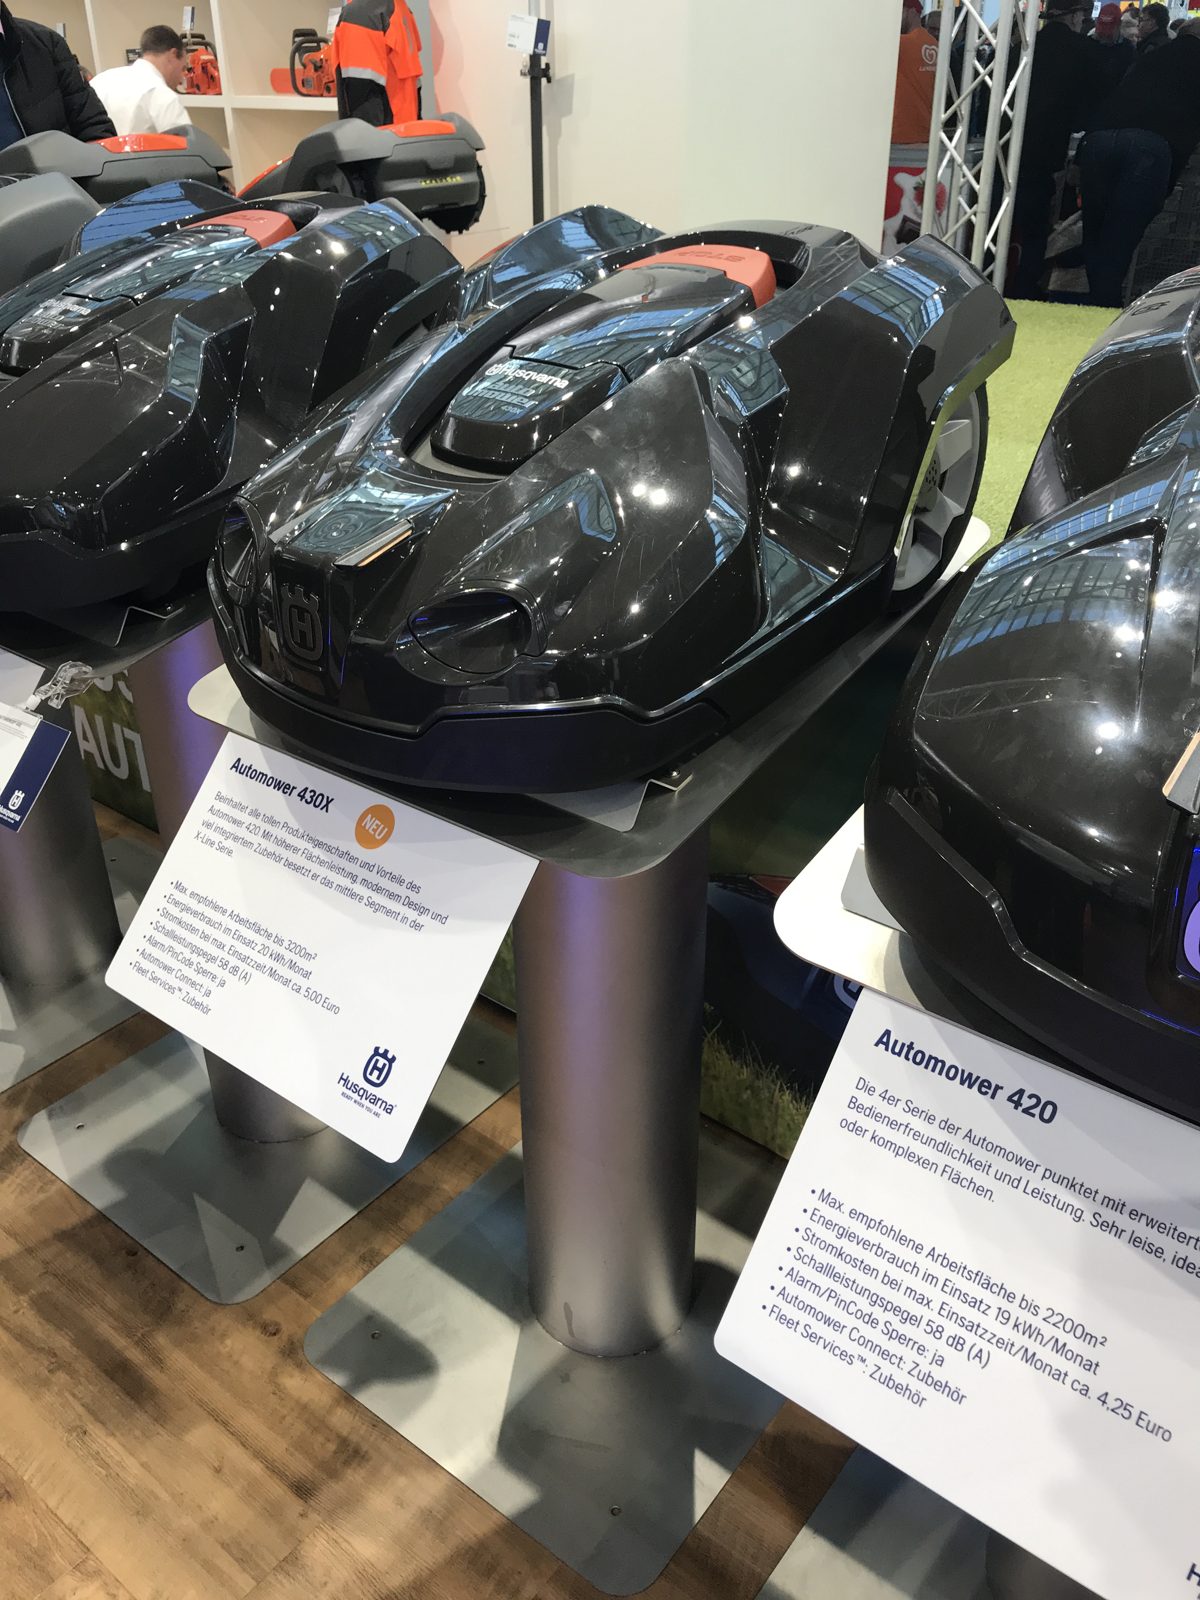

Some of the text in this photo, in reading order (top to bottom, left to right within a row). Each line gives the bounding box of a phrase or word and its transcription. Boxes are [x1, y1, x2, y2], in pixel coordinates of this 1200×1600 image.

[499, 362, 570, 389] Husqvarna
[229, 757, 334, 813] Automower 430X
[361, 813, 389, 840] NEU
[193, 829, 216, 848] X-Line
[201, 819, 425, 932] viel integriertem Zubehör besetzt er das mittlere Segment in der
[207, 804, 245, 828] Automower
[260, 828, 273, 842] Mit
[271, 834, 302, 855] höherer
[359, 877, 402, 903] modernem
[401, 895, 431, 917] Design
[430, 911, 449, 925] und
[214, 790, 422, 894] Beinhaltet alle tollen Produkteigenschaften und Vorteile des
[145, 934, 194, 969] Alarm/PinCode
[215, 975, 227, 988] ja
[159, 906, 200, 937] Stromkosten
[199, 928, 212, 943] bei
[226, 944, 292, 988] Einsatzzeit/Monat
[320, 996, 340, 1015] Euro
[166, 893, 313, 980] Energieverbrauch im Einsatz 20 kWh/Monat
[188, 890, 228, 916] empfohlene
[226, 909, 273, 941] Arbeitsfläche
[272, 932, 285, 947] bis
[284, 939, 318, 962] 3200m²
[217, 956, 230, 971] 58
[228, 964, 240, 977] dB
[237, 968, 252, 985] (A)
[132, 960, 150, 978] Fleet
[181, 990, 212, 1015] Zubehör
[138, 947, 176, 975] Automower
[201, 986, 212, 998] ja
[337, 1072, 394, 1116] Husqvarna
[873, 1028, 1058, 1124] Automower 420
[839, 1118, 994, 1203] oder komplexen Flächen.
[847, 1095, 992, 1176] Bedienerfreundlichkeit
[993, 1168, 1023, 1190] und
[1022, 1179, 1085, 1223] Leistung.
[1089, 1211, 1127, 1239] Sehr
[1127, 1229, 1166, 1263] leise,
[855, 1076, 1200, 1251] Die 4er Serie der Automower punktet mit erweitert
[809, 1207, 1100, 1376] Energieverbrauch im Einsatz 19 kWh/Monat
[817, 1188, 1108, 1348] Max. empfohlene Arbeitsfläche bis 2200m²
[768, 1303, 800, 1333] Fleet
[868, 1363, 927, 1407] Zubehör
[776, 1285, 848, 1335] Automower
[906, 1360, 967, 1405] Zubehör
[784, 1266, 879, 1329] Alarm/PinCode
[928, 1348, 945, 1368] ja
[801, 1226, 879, 1280] Stromkosten
[880, 1270, 903, 1293] bei
[903, 1285, 934, 1311] max.
[937, 1300, 1069, 1385] Einsatzzeit/Monat
[1070, 1378, 1091, 1399] ca.
[1135, 1410, 1172, 1442] Euro
[923, 1318, 945, 1340] 58
[945, 1333, 966, 1352] dB
[967, 1342, 991, 1369] (A)
